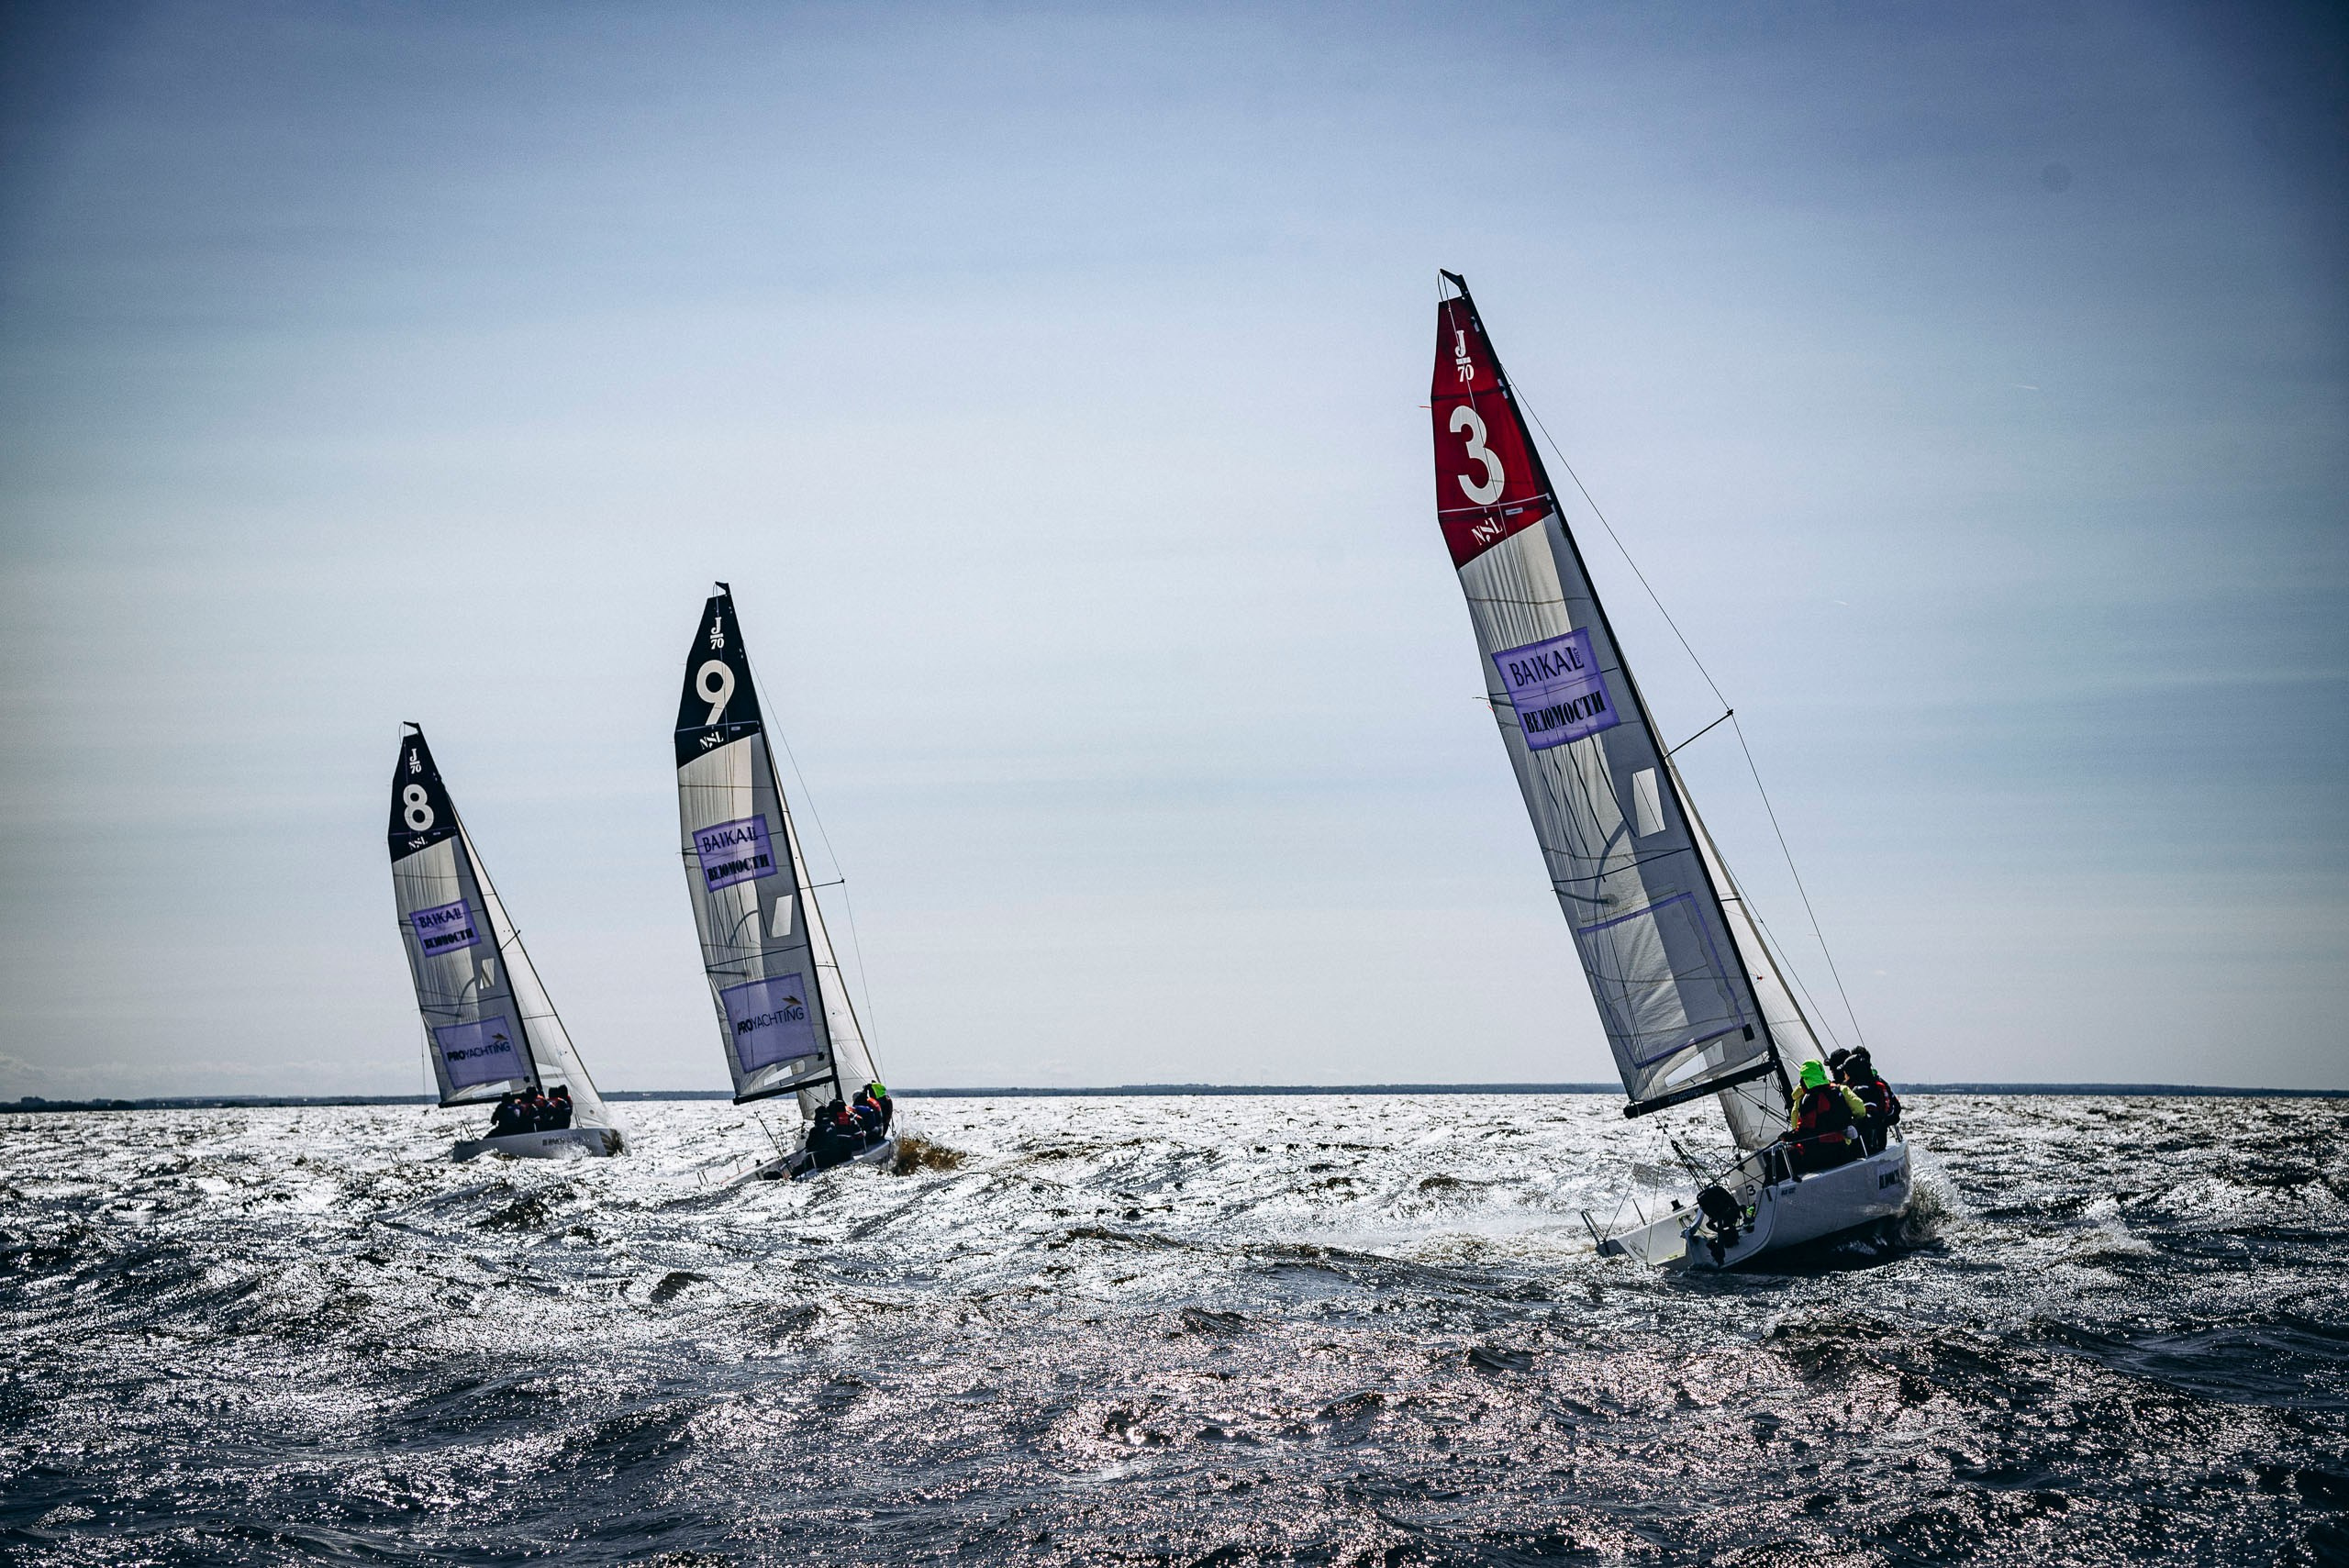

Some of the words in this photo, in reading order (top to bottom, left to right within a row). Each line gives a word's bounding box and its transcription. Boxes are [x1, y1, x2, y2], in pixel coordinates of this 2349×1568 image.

[1454, 330, 1466, 357] J
[1457, 364, 1475, 383] 70
[1450, 406, 1505, 505] 3
[710, 617, 722, 634] J
[711, 638, 724, 650] 70
[1508, 647, 1585, 686] BAIKAL
[696, 660, 735, 725] 9
[409, 748, 417, 762] J
[410, 764, 421, 773] 70
[403, 784, 434, 831] 8
[702, 827, 758, 852] BAIKAL
[418, 907, 463, 929] BAIKAL
[738, 1007, 804, 1035] PROYACHTING
[447, 1041, 510, 1062] PROYACHTING
[1746, 1184, 1756, 1196] 3
